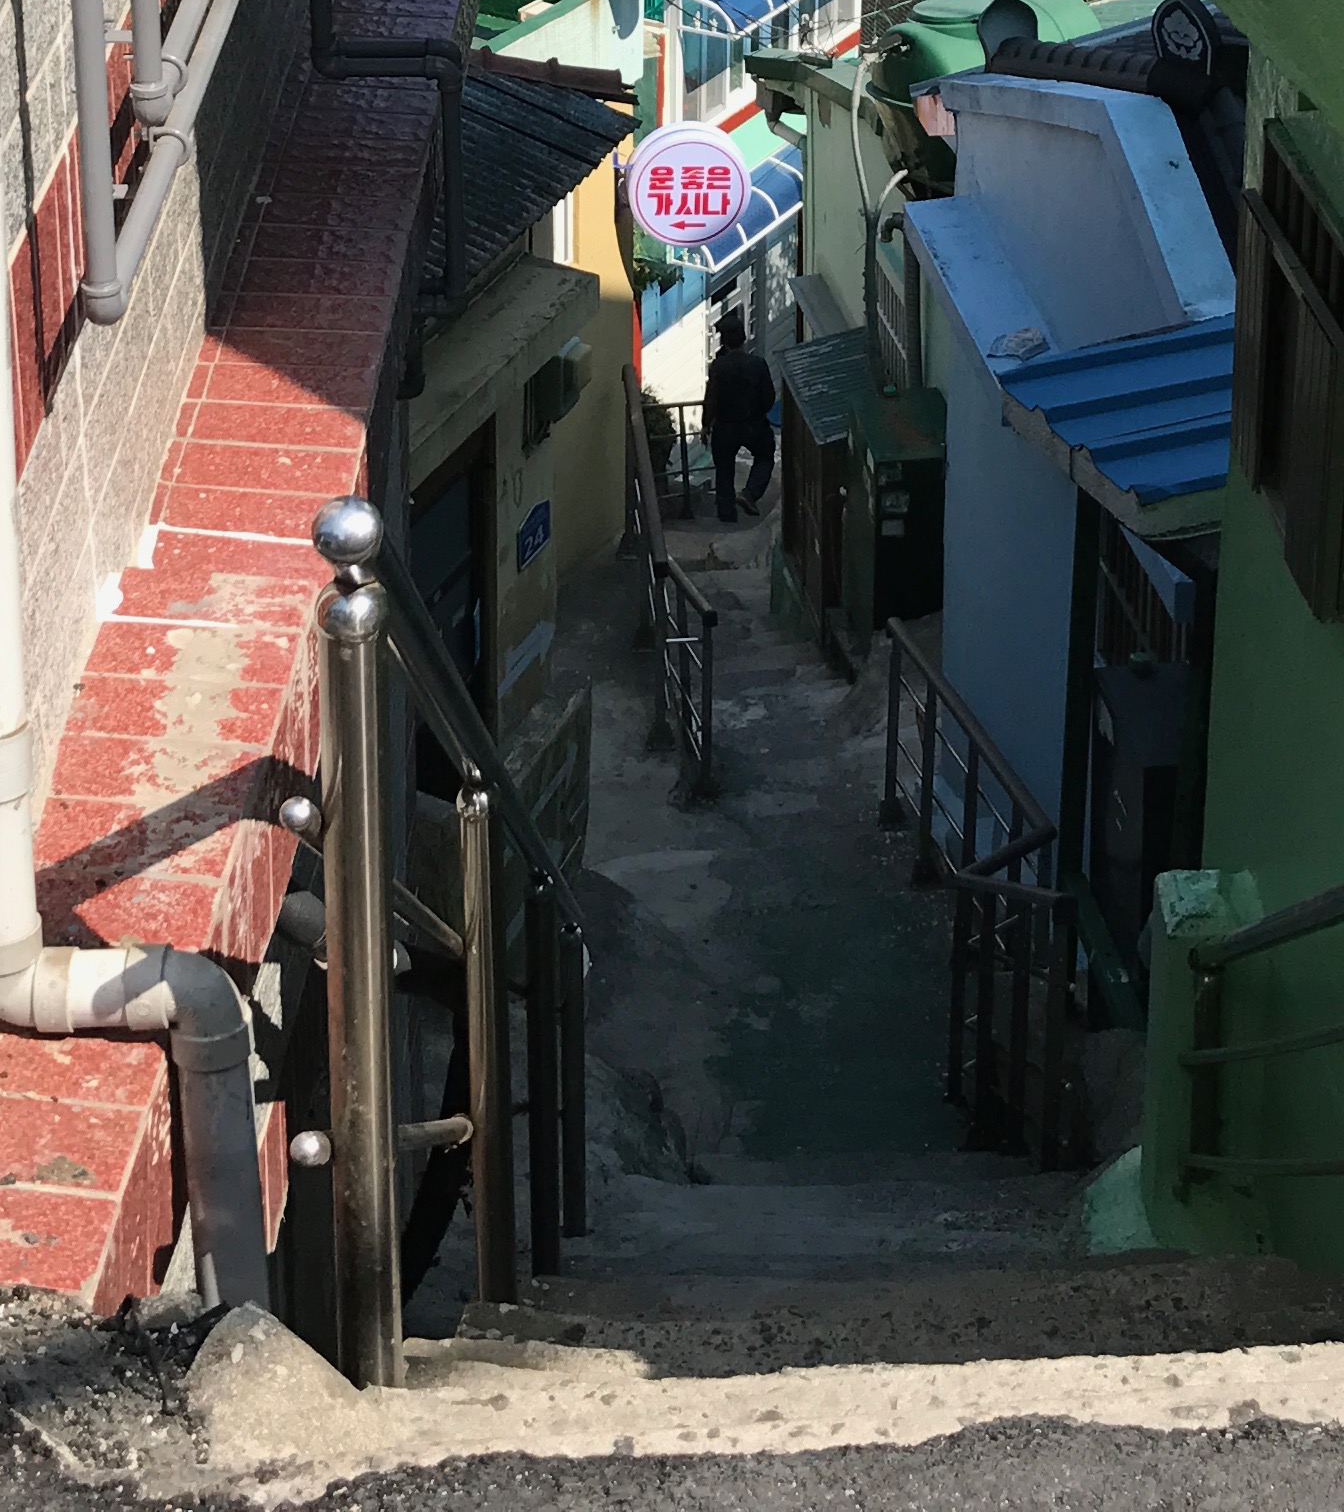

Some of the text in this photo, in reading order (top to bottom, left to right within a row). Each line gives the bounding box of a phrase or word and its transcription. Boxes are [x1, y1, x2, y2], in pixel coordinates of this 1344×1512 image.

[649, 166, 731, 191] 운 좋은
[647, 192, 731, 216] 가시나
[524, 524, 545, 560] 24
